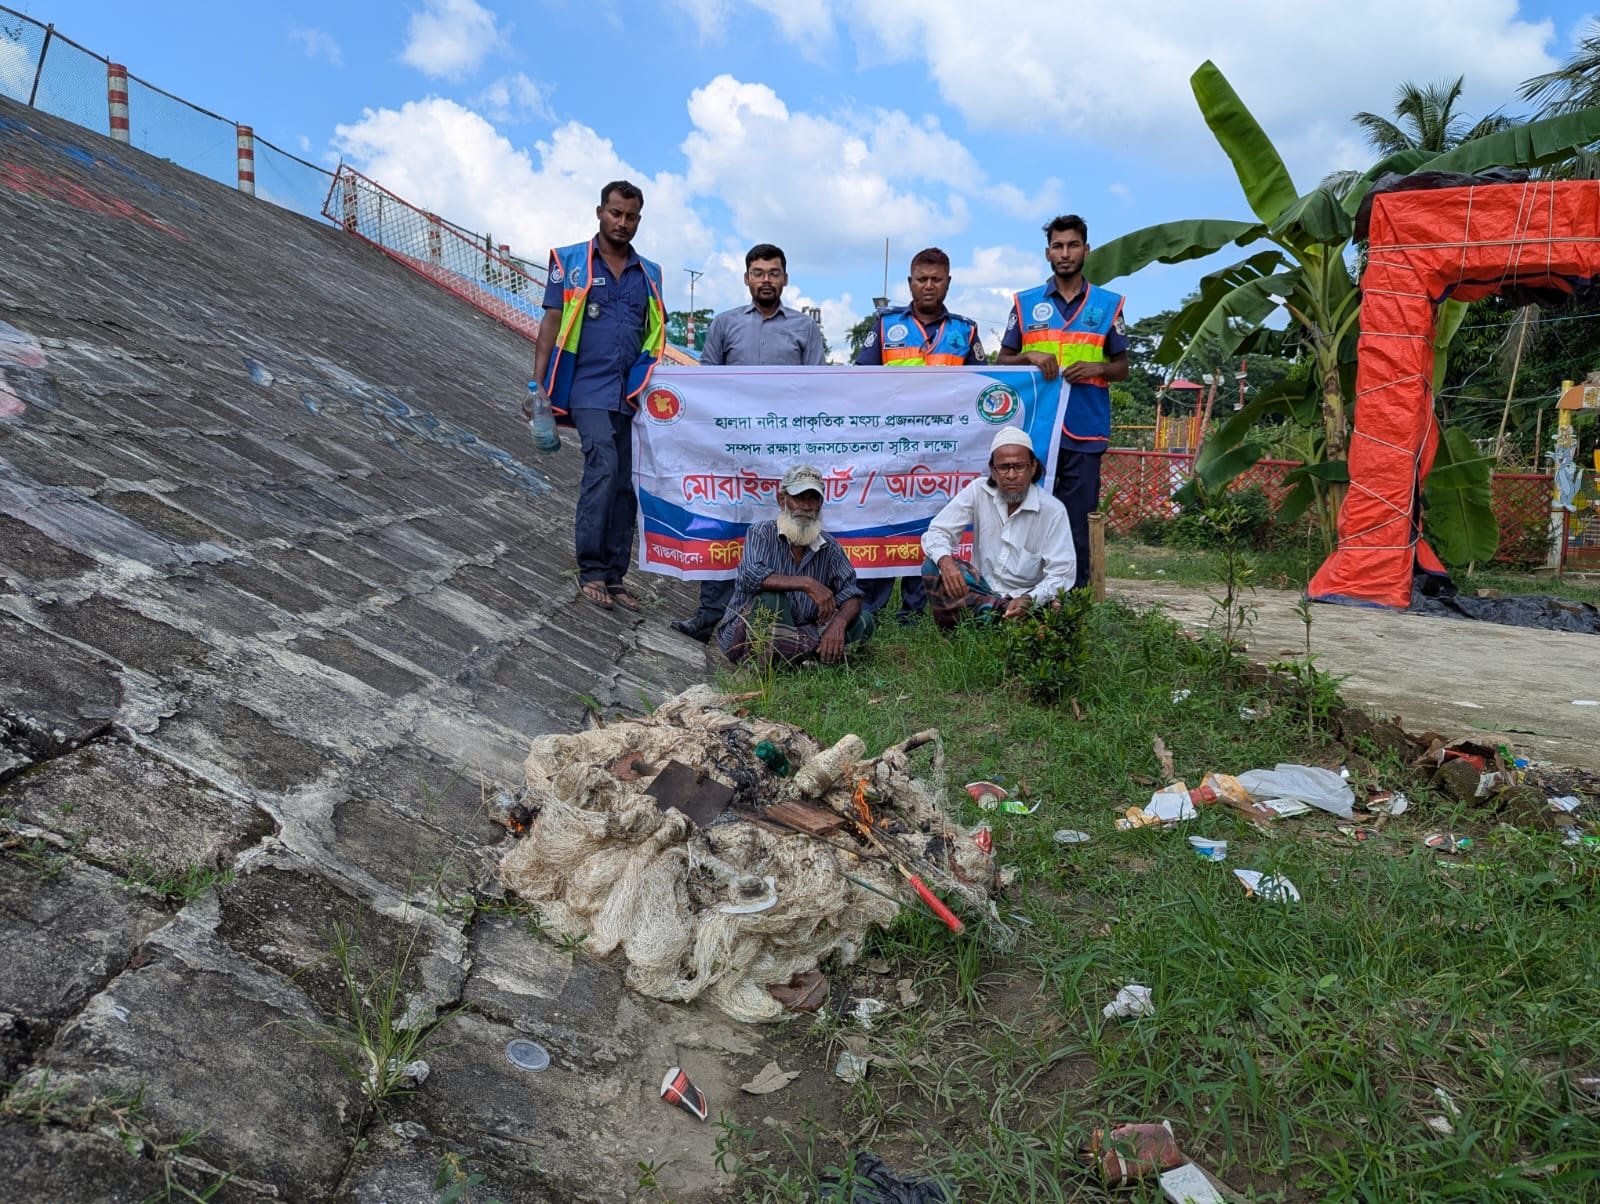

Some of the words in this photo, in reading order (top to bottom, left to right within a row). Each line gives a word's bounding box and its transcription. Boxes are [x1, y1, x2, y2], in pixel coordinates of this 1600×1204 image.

[713, 416, 752, 429] হালদা
[756, 411, 788, 429] নদীর
[792, 411, 846, 433] প্রাকৃতিক
[848, 415, 881, 427] মৎস্য
[885, 414, 954, 427] প্রজননক্ষেত্র
[959, 414, 969, 425] ও
[725, 442, 762, 455] সম্পদ
[766, 442, 801, 455] রক্ষায়
[805, 441, 884, 454] জনসচেতনতা
[888, 437, 920, 457] সৃষ্টির
[923, 440, 959, 453] লক্ষ্যে
[683, 468, 782, 502] মোবাইল
[859, 470, 877, 505] /
[883, 542, 920, 561] দপ্তর
